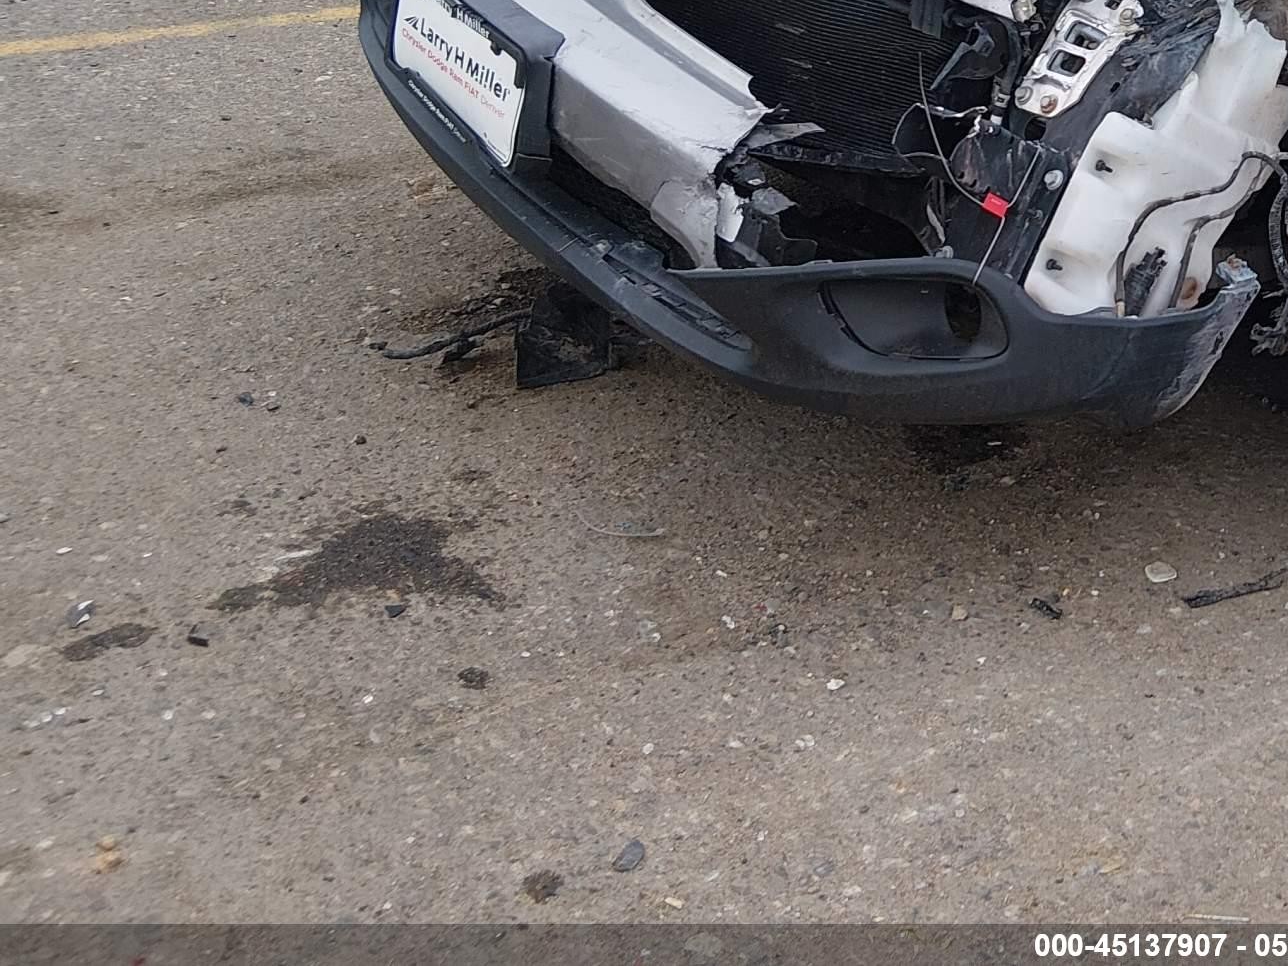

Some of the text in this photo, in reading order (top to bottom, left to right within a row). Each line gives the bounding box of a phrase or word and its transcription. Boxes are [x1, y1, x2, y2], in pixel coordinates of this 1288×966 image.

[420, 17, 510, 101] Larry H Miller
